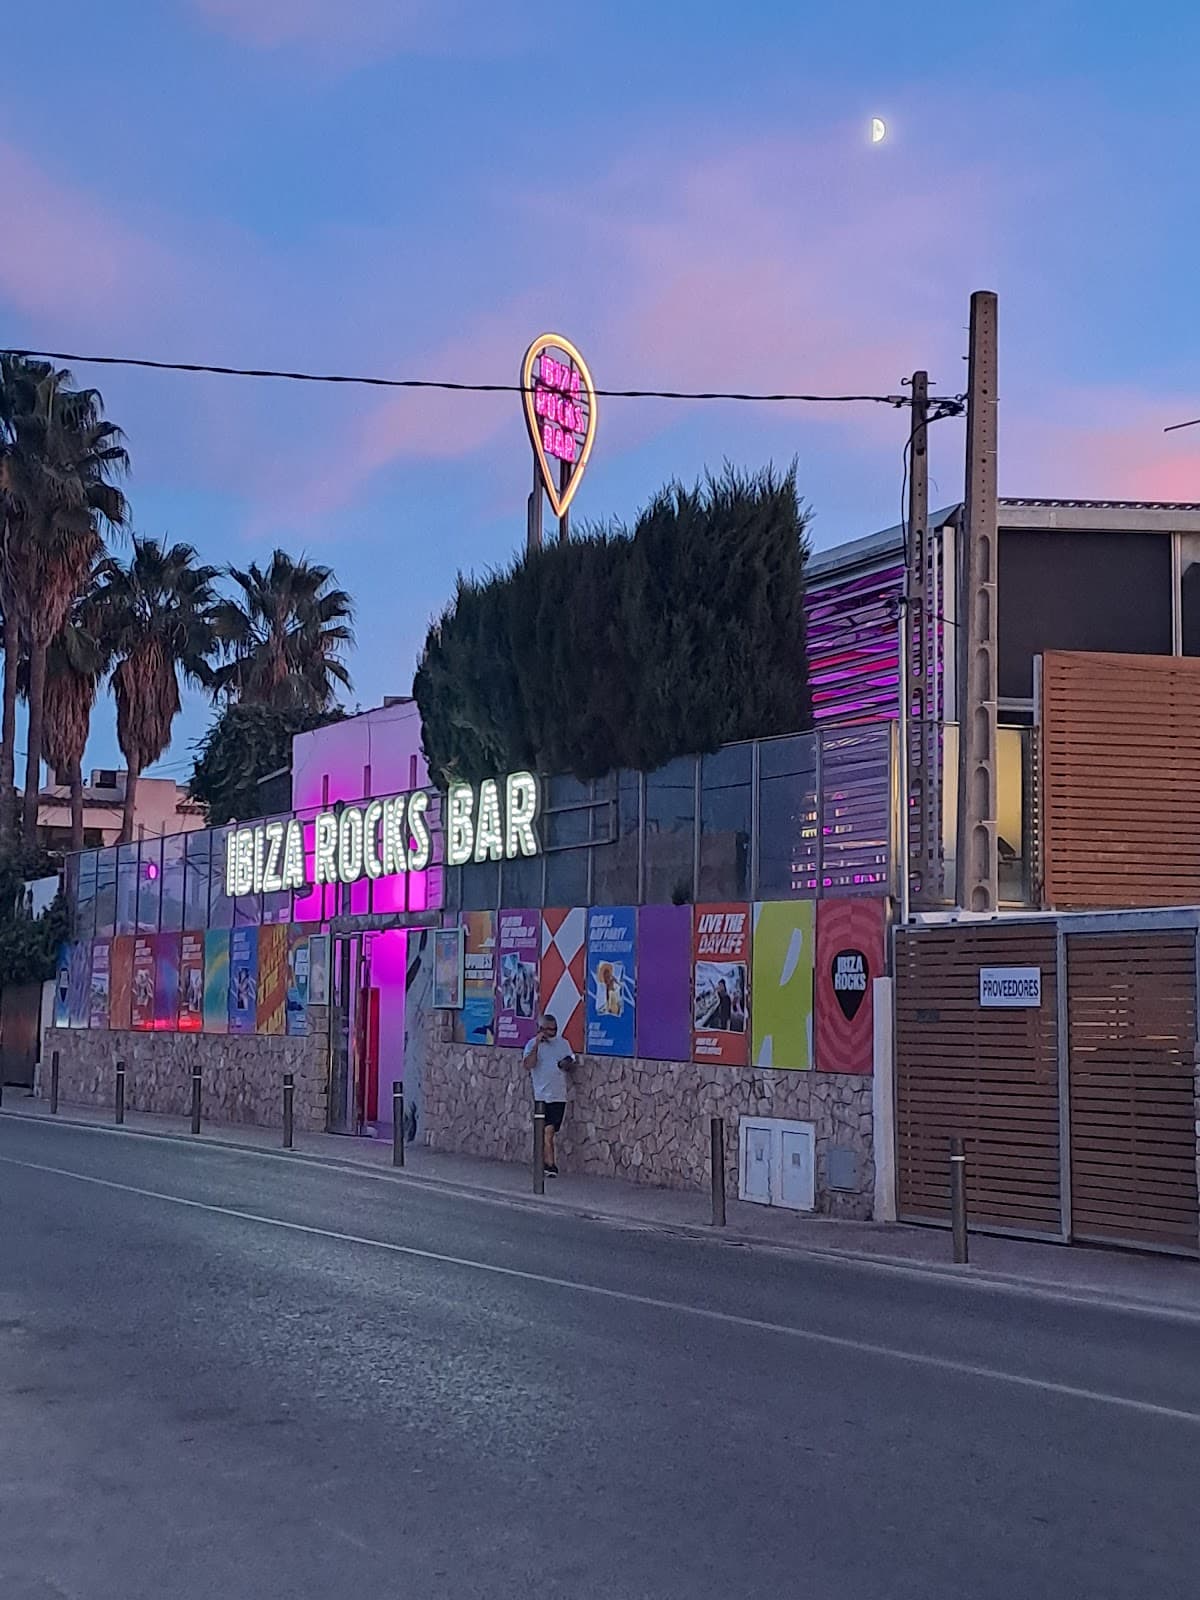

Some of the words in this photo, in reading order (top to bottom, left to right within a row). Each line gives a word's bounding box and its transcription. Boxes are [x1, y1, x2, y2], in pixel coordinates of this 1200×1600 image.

[540, 355, 581, 400] IBIZA
[536, 387, 584, 433] ROCKS
[543, 424, 577, 463] BAR
[226, 819, 304, 897] IBIZA
[315, 791, 429, 884] ROCKS
[447, 771, 537, 865] BAR
[698, 914, 724, 933] LIVE
[724, 913, 746, 933] THE
[698, 933, 745, 954] DAYLIFE
[837, 955, 863, 973] IBIZA
[834, 972, 867, 990] ROCKS
[983, 979, 1039, 997] PROVEEDORES
